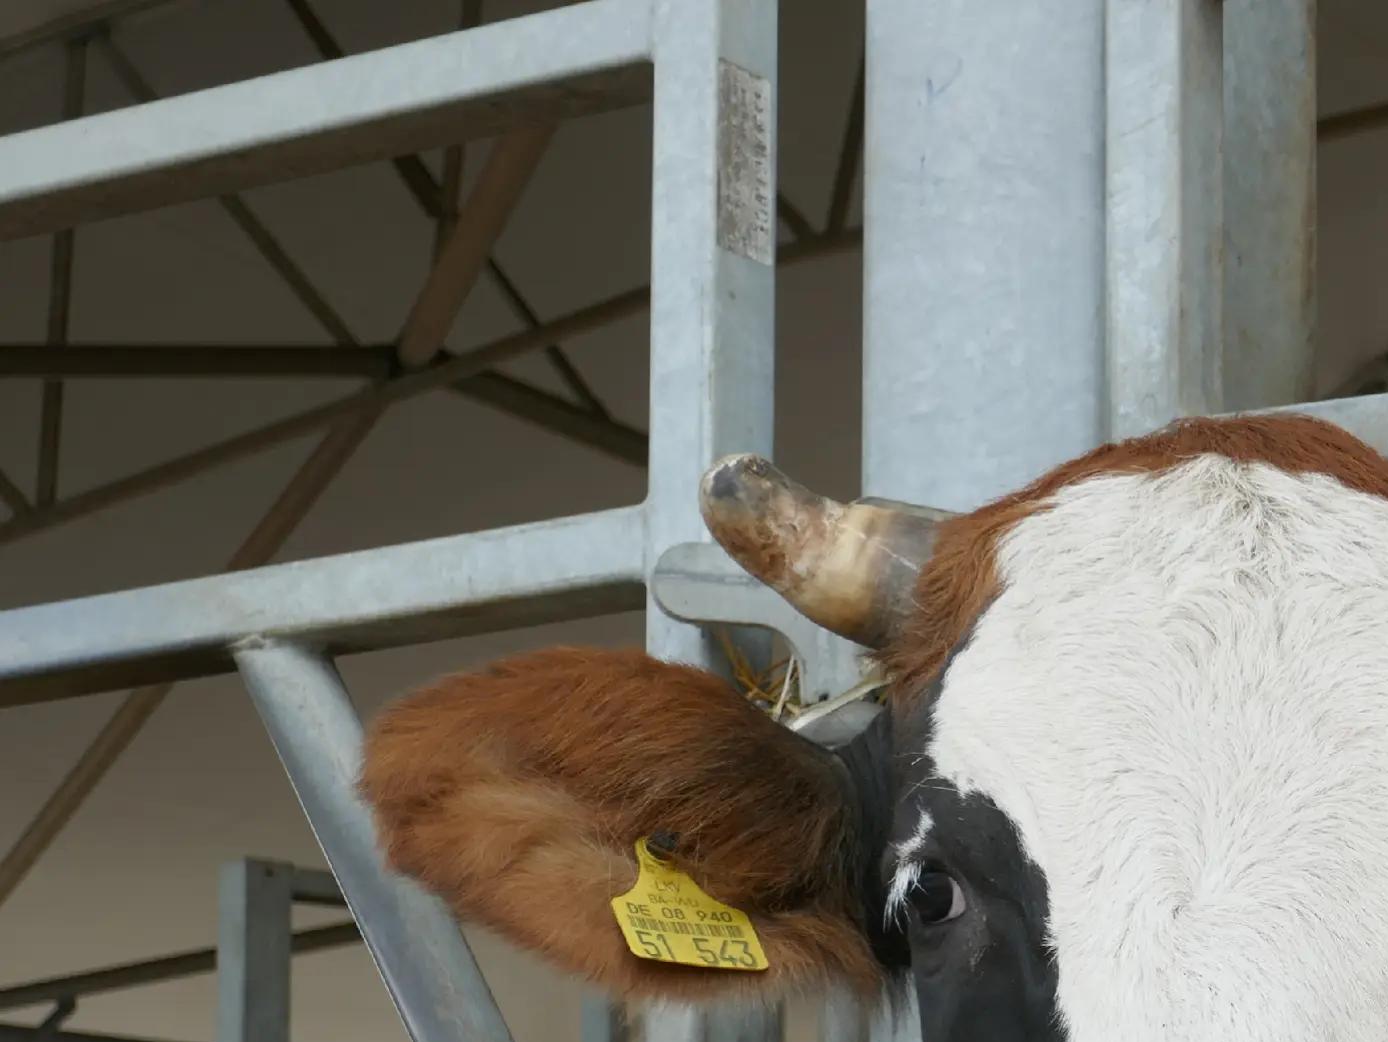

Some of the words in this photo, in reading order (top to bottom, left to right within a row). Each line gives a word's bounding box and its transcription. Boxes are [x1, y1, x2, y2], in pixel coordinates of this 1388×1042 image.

[626, 902, 651, 916] DE
[661, 907, 686, 920] 08
[696, 910, 733, 923] 940
[635, 930, 677, 961] 51
[692, 938, 758, 968] 543
